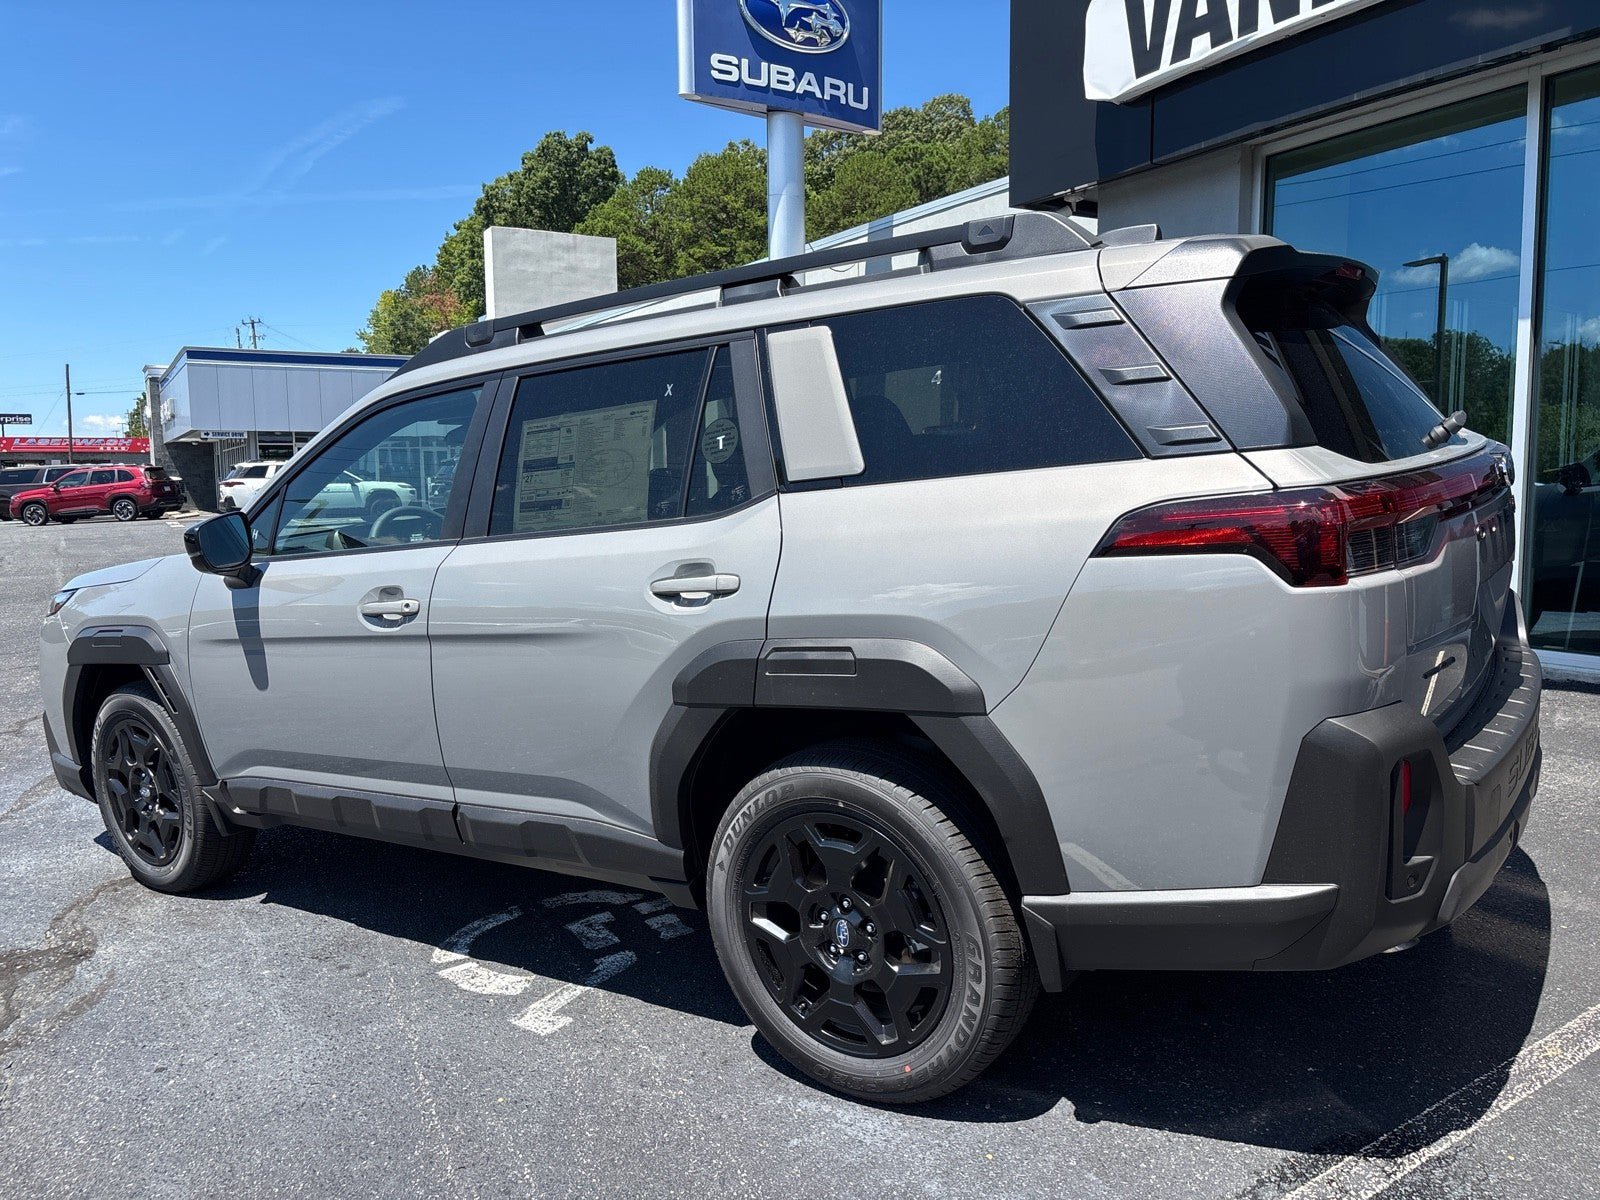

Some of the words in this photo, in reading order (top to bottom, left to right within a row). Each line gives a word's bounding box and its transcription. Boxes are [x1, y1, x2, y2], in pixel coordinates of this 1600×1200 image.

[1125, 0, 1336, 80] VA
[710, 52, 869, 111] SUBARU
[931, 370, 942, 385] 4
[664, 383, 674, 397] X
[716, 434, 726, 450] T
[252, 528, 259, 540] H
[722, 783, 795, 858] DUNLOP
